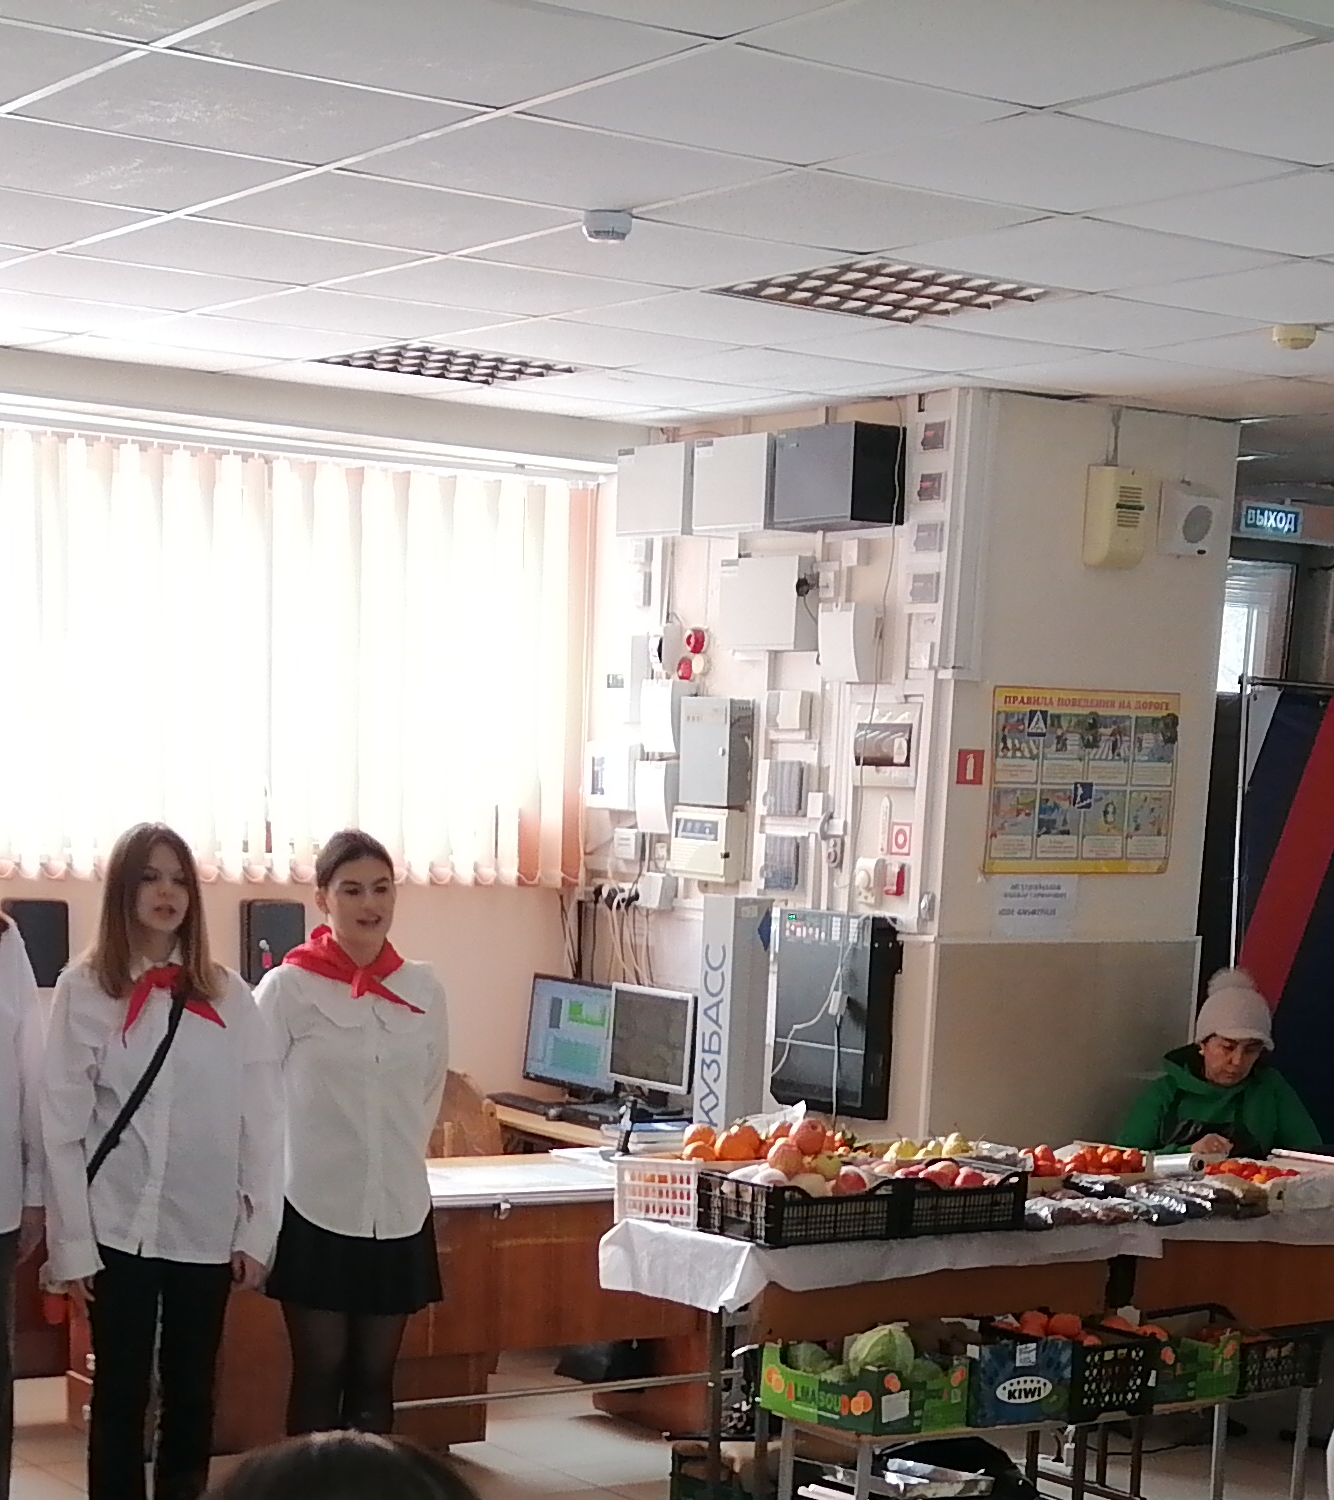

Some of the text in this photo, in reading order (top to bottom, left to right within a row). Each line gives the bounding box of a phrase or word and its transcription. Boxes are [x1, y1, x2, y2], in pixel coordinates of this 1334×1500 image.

[1247, 509, 1296, 534] ВЫХОД
[1003, 694, 1054, 707] ПРАВИЛА
[698, 943, 727, 1128] КУЗБАСС
[1007, 1386, 1041, 1400] KIWI
